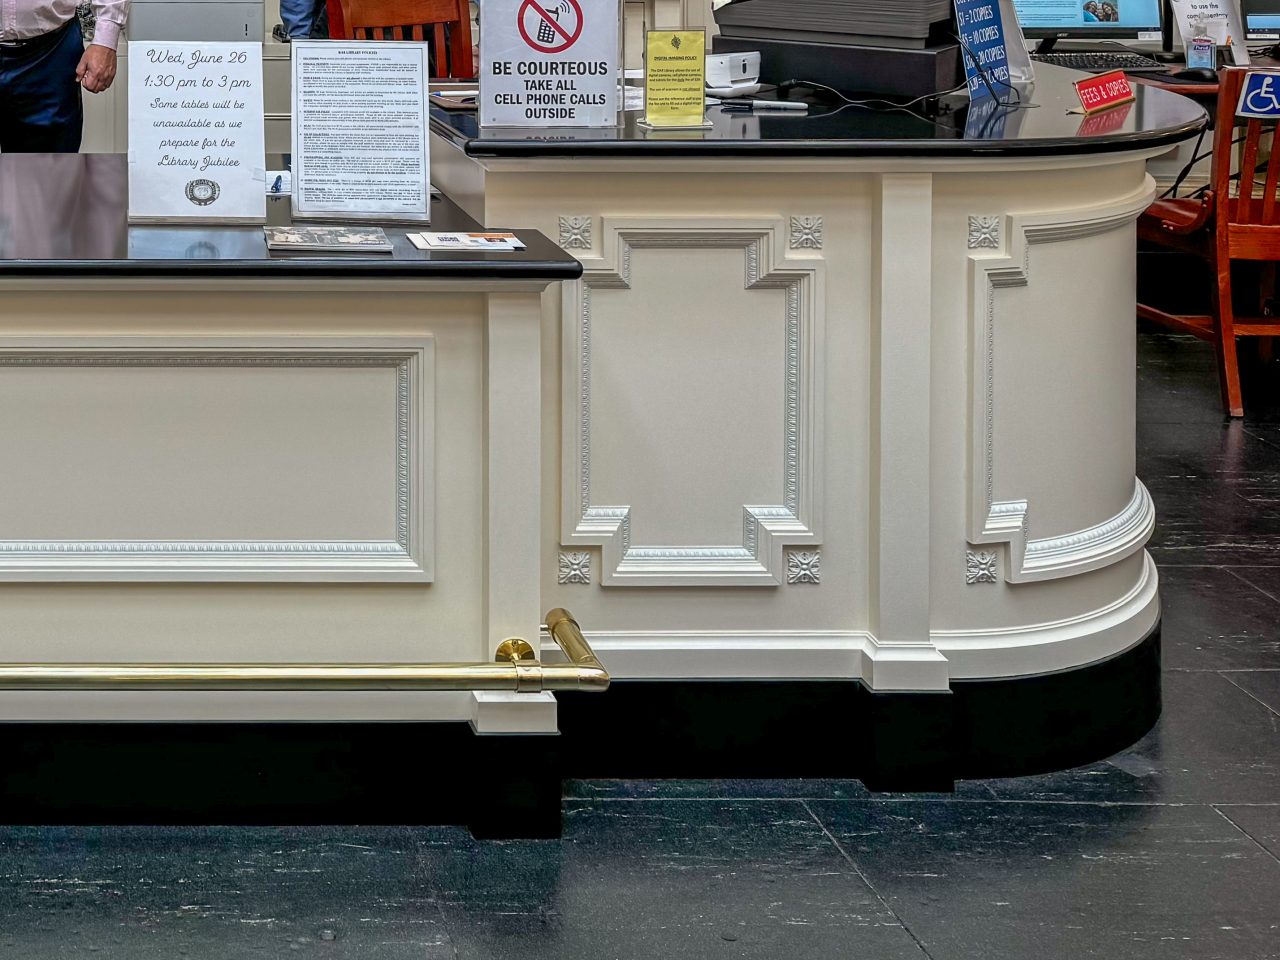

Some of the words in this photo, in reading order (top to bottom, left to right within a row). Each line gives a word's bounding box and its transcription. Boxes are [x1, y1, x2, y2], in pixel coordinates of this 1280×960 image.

[1191, 2, 1197, 10] to
[973, 5, 993, 23] COPIES
[979, 25, 999, 43] COPIES
[146, 48, 185, 65] Wed,
[188, 49, 222, 70] June
[227, 51, 247, 64] 26
[984, 45, 1005, 63] COPIES
[492, 61, 512, 75] BE
[517, 61, 608, 75] COURTEOUS
[144, 74, 175, 88] 1:30
[176, 78, 197, 91] pm
[202, 76, 213, 88] to
[218, 75, 228, 88] 3
[229, 79, 252, 91] pm
[524, 80, 552, 91] TAKE
[556, 80, 576, 91] ALL
[1080, 87, 1100, 104] FEES
[1099, 85, 1107, 99] &
[1106, 78, 1130, 97] COPIES
[150, 97, 178, 109] Some
[180, 100, 209, 109] tables
[212, 100, 230, 109] will
[234, 100, 244, 109] be
[494, 93, 522, 105] CELL
[526, 93, 566, 105] PHONE
[570, 93, 606, 105] CALLS
[525, 108, 575, 119] OUTSIDE
[153, 119, 210, 128] unavailable
[159, 139, 199, 150] prepare
[201, 138, 217, 150] for
[221, 138, 236, 147] the
[158, 154, 198, 169] Library
[200, 155, 240, 171] Jubilee
